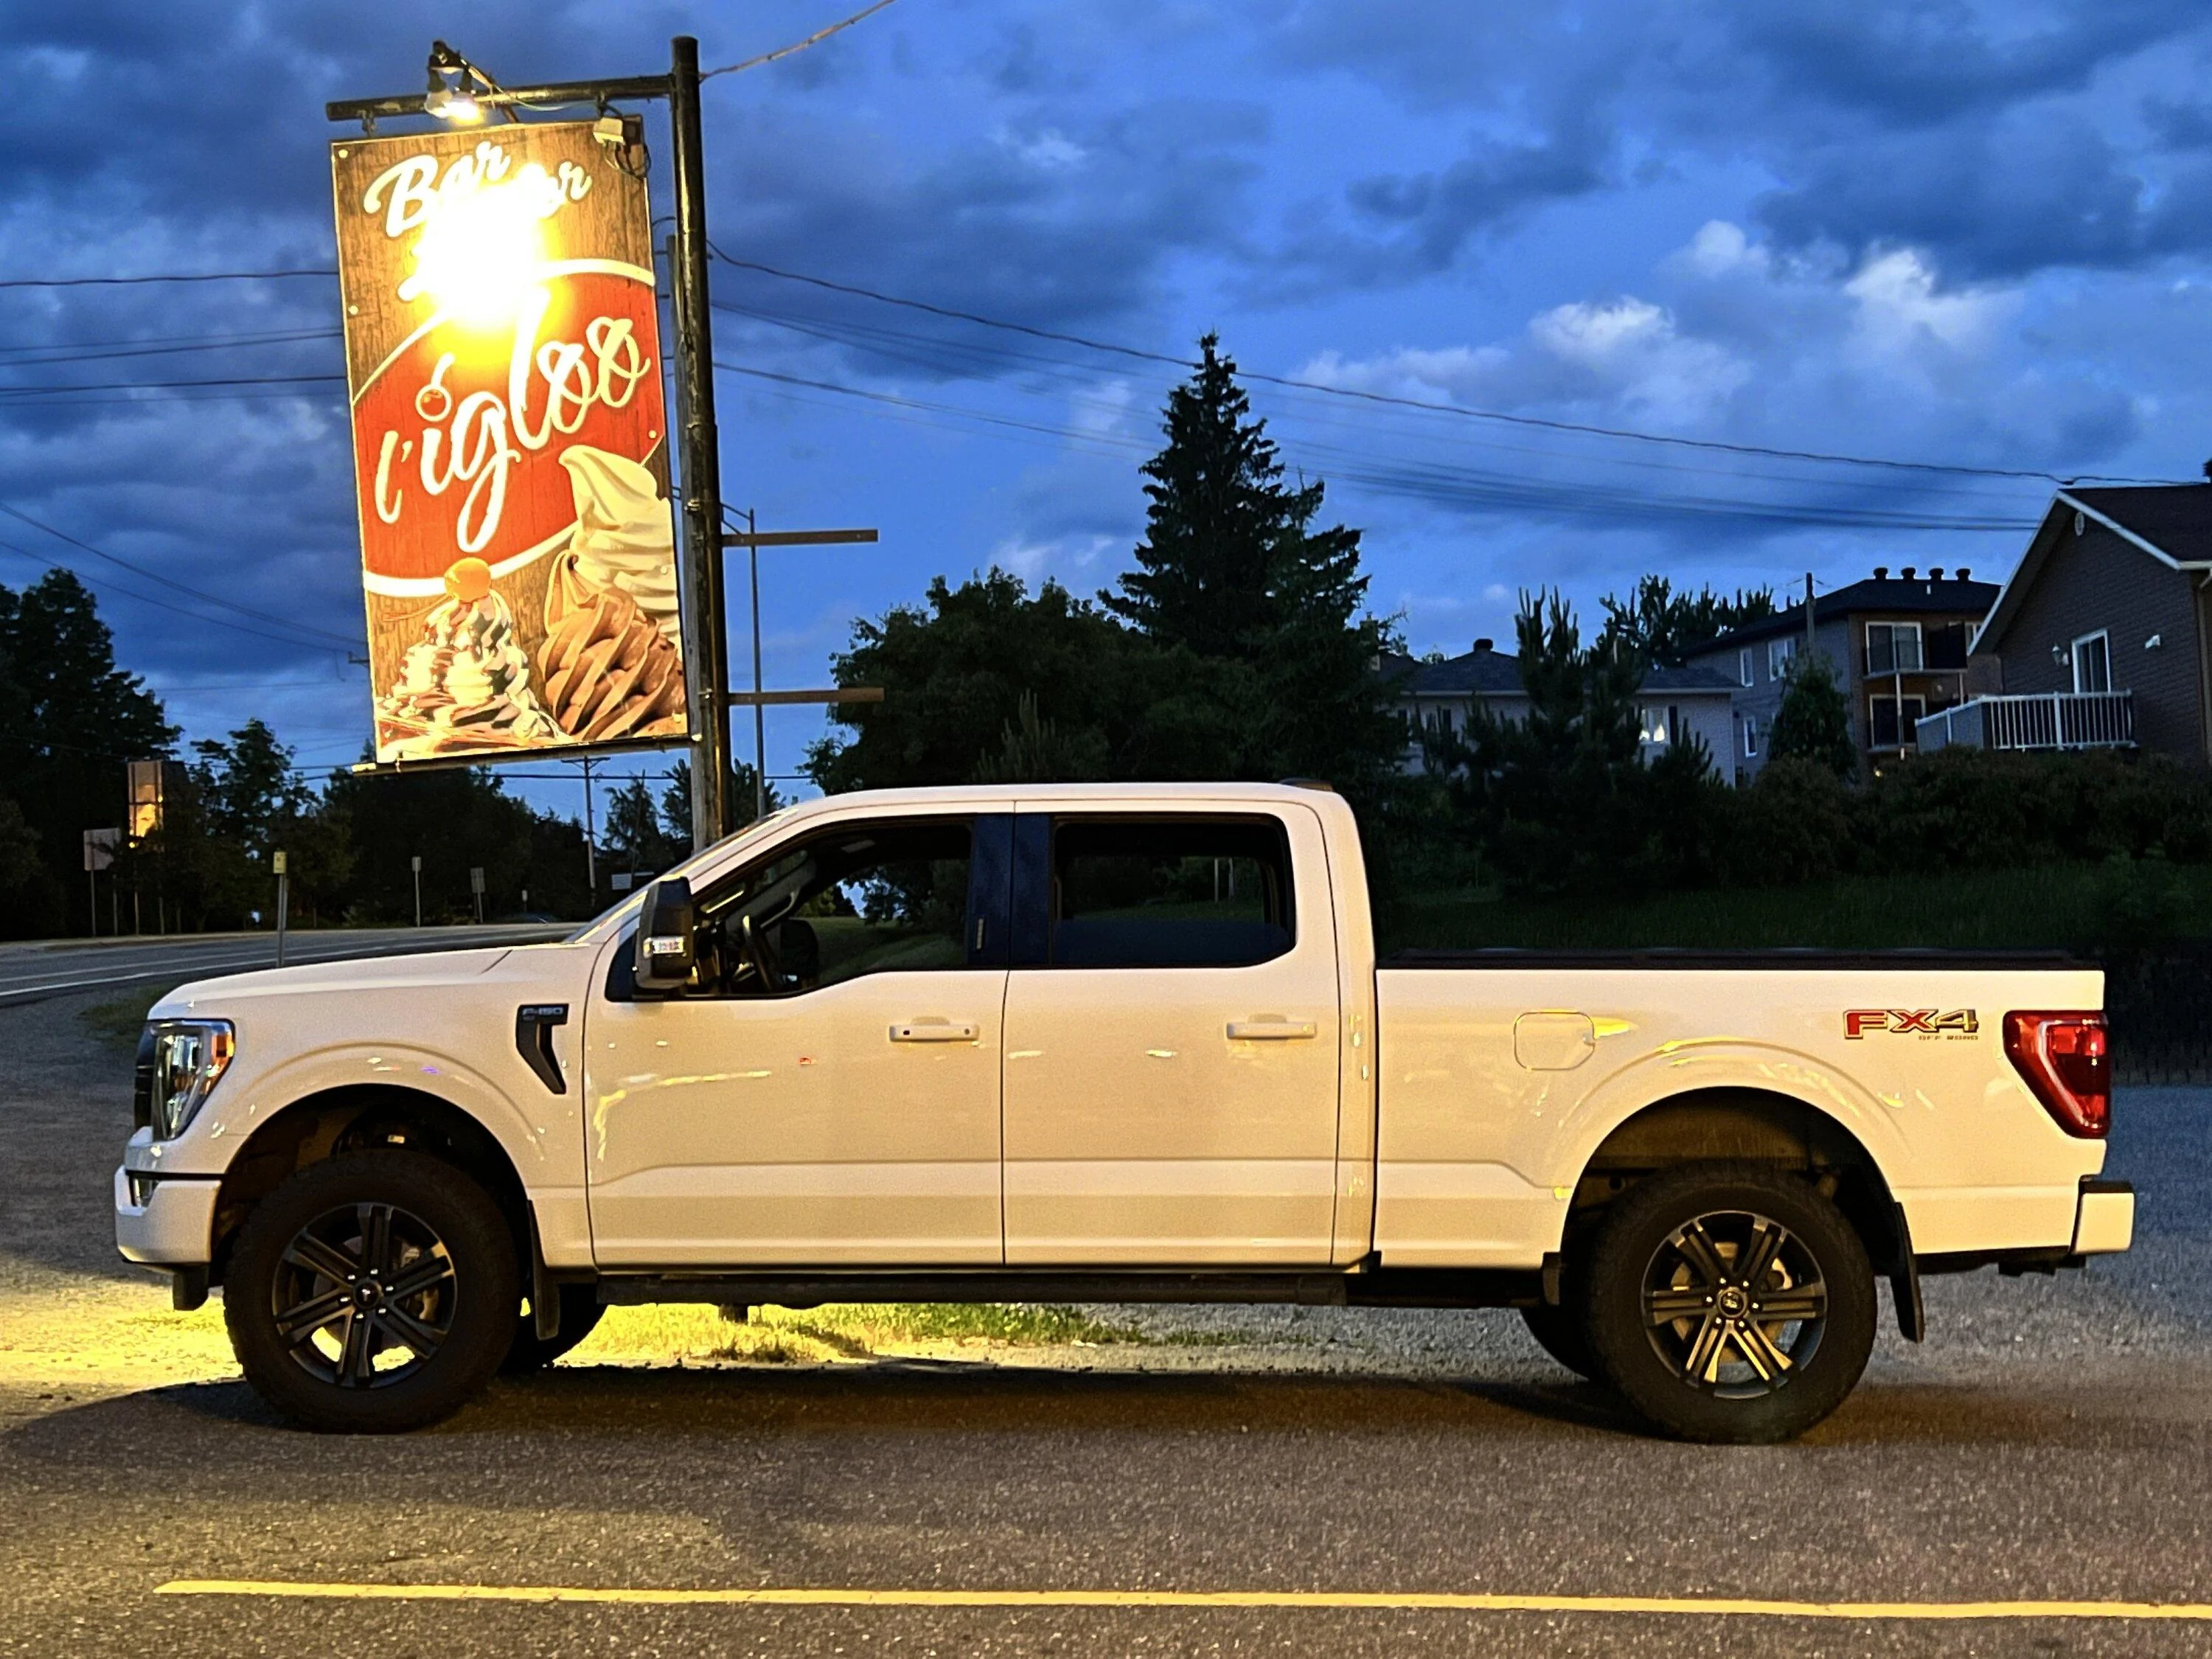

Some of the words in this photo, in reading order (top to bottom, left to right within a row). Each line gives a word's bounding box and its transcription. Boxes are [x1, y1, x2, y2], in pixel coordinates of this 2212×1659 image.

[363, 142, 512, 237] Bar
[375, 285, 651, 553] l'igloo
[1843, 1009, 1979, 1040] FX4
